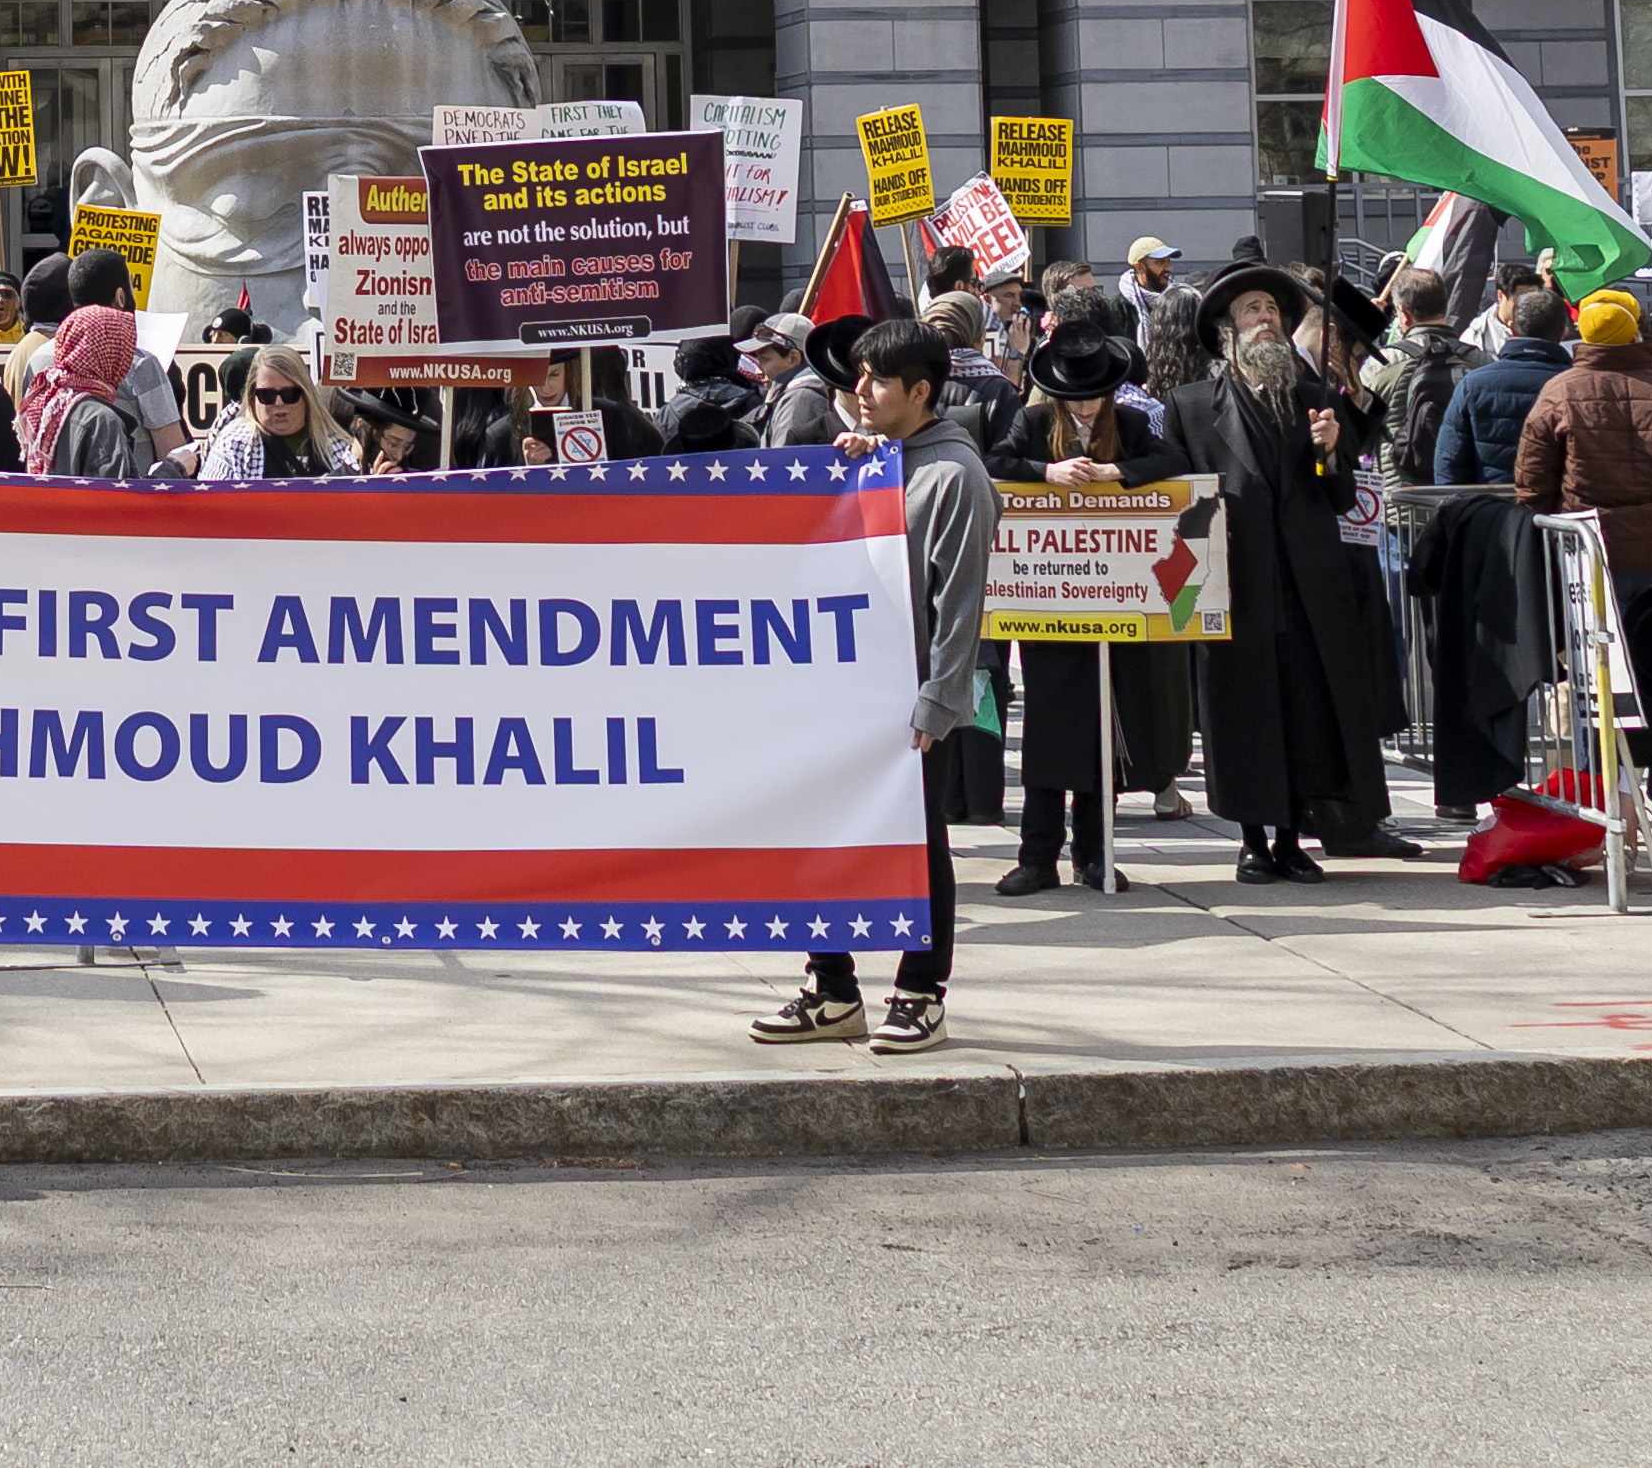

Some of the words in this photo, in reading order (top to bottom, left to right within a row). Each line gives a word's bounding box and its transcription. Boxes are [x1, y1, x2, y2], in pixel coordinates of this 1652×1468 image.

[443, 111, 526, 130] DEMOCRATS
[551, 106, 589, 124] FIRST
[594, 104, 622, 121] THEY
[704, 102, 786, 130] CAPITALISM
[862, 111, 919, 140] RELEASE
[725, 127, 782, 150] OTTING
[868, 131, 922, 156] MAHMOUD
[998, 122, 1066, 143] RELEASE
[872, 148, 923, 169] KHALIL!
[998, 141, 1066, 159] MAHMOUD
[458, 164, 505, 186] The
[512, 160, 579, 183] State
[586, 156, 610, 178] of
[618, 153, 688, 178] Israel
[746, 163, 771, 184] FOR
[997, 157, 1066, 169] KHALIL!
[873, 174, 906, 194] HANDS
[908, 167, 927, 187] OFF
[994, 177, 1040, 194] HANDS
[1044, 178, 1067, 194] OFF
[484, 187, 529, 210] and
[536, 185, 567, 207] its
[575, 182, 667, 205] actions
[875, 194, 891, 208] OUR
[891, 185, 929, 204] STUDENTS!
[1015, 195, 1066, 206] STUDENTS!
[932, 180, 996, 237] PALESTINE
[979, 194, 1007, 225] BE
[77, 209, 157, 233] PROTESTING
[463, 230, 492, 246] are
[498, 224, 530, 244] not
[534, 221, 565, 243] the
[570, 217, 653, 241] solution,
[657, 214, 690, 236] but
[944, 213, 982, 247] WILL
[75, 227, 155, 245] AGAINST
[338, 229, 391, 262] always
[969, 217, 1023, 279] REE!
[465, 259, 502, 281] the
[508, 255, 566, 279] main
[571, 254, 655, 275] causes
[659, 248, 692, 271] for
[501, 277, 659, 307] anti-semitism
[378, 301, 397, 315] and
[400, 300, 416, 315] the
[334, 317, 384, 346] State
[388, 316, 403, 345] of
[538, 323, 634, 338] www.NKUSA.org
[389, 364, 512, 384] www.NKUSA.org
[1003, 493, 1062, 509] Torah
[1069, 491, 1171, 509] Demands
[1027, 529, 1158, 553] PALESTINE
[1013, 560, 1028, 575] be
[1033, 561, 1091, 576] returned
[1095, 562, 1109, 576] to
[985, 580, 1056, 599] alestinian
[1061, 583, 1149, 604] Sovereignty
[257, 593, 870, 667] AMENDMENT
[999, 620, 1137, 636] www.nkusa.org
[350, 715, 686, 786] KHALIL
